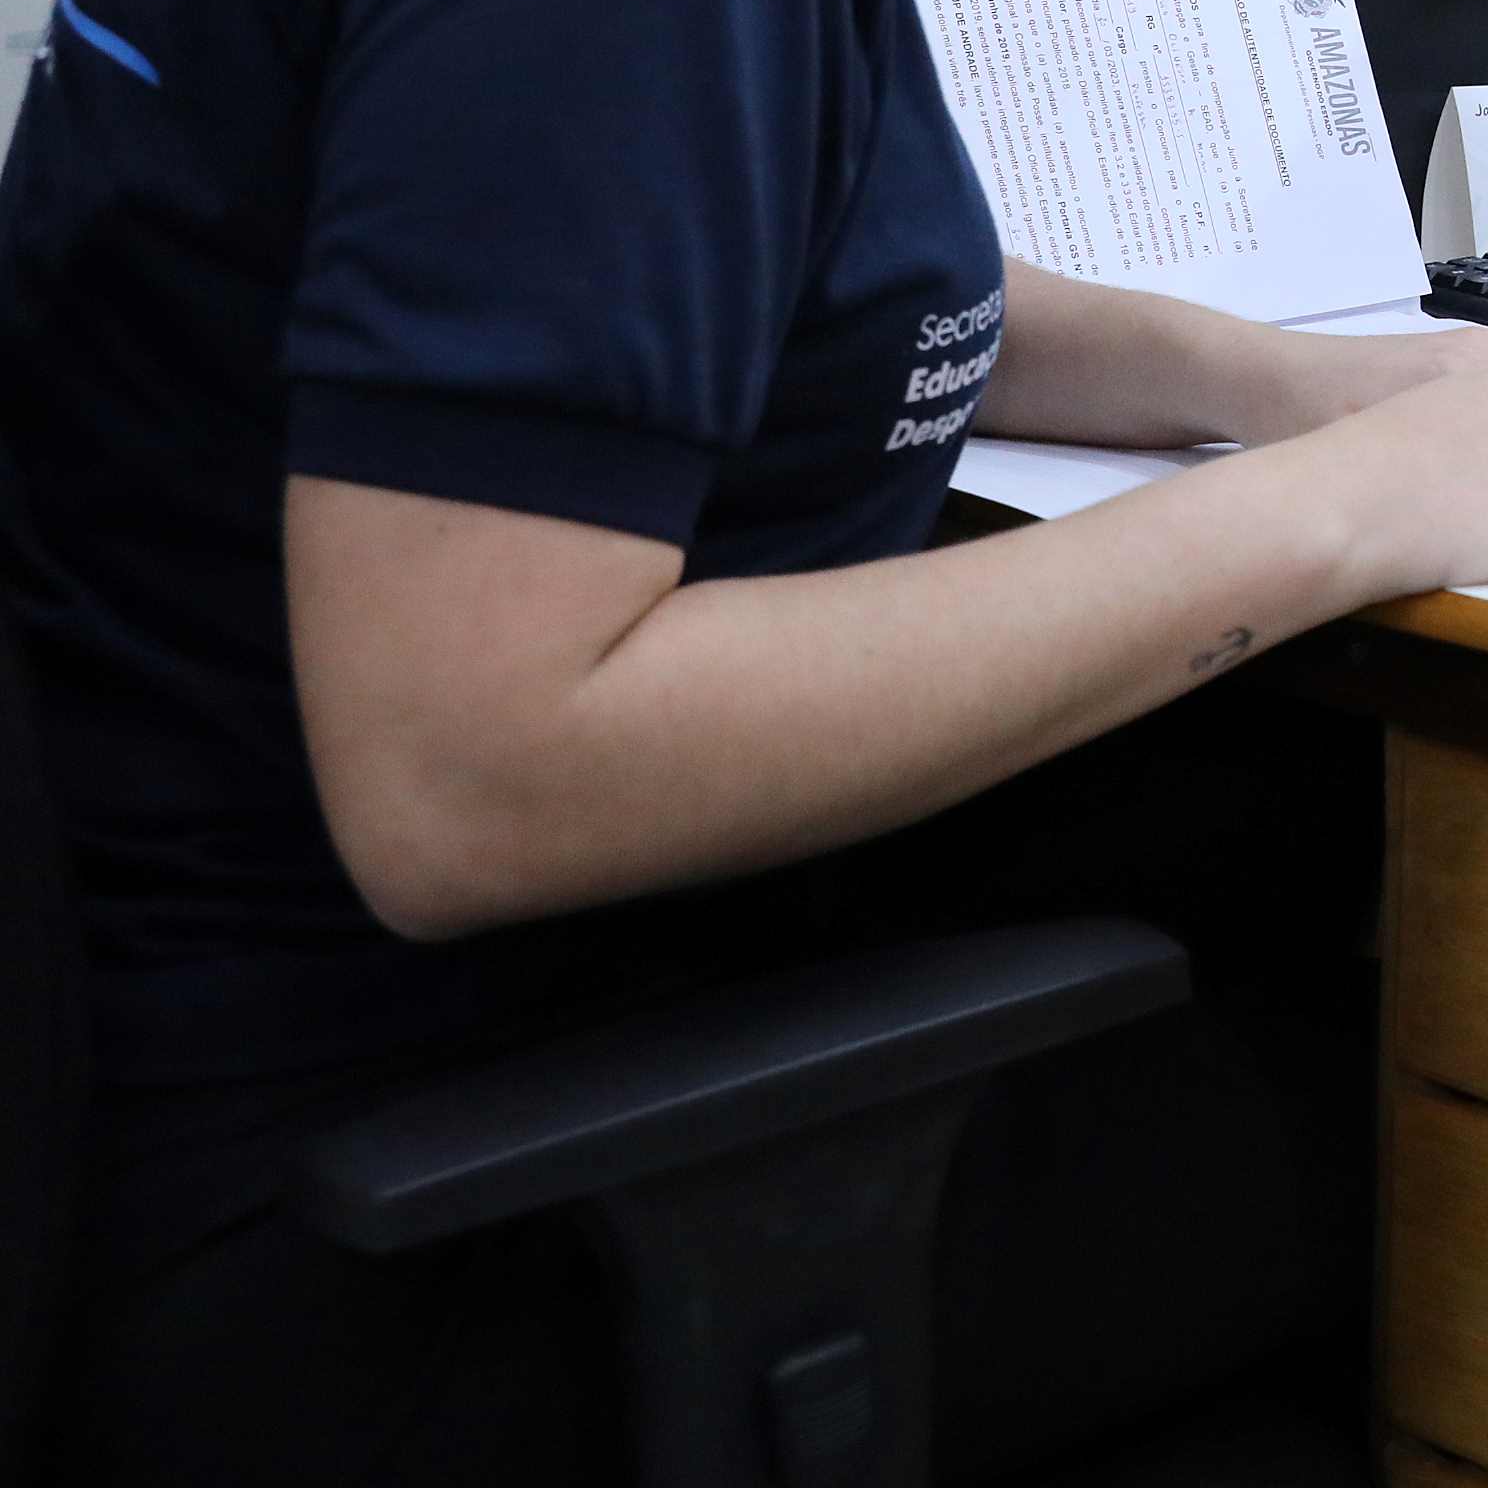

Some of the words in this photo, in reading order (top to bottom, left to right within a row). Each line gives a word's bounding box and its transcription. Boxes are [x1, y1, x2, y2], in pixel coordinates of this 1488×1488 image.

[1237, 10, 1249, 24] DE
[995, 36, 1012, 63] 2019,
[1112, 26, 1129, 54] Cargo
[1192, 17, 1204, 36] para
[1208, 81, 1232, 140] comprovação
[1242, 27, 1271, 105] AUTENTICIDADE
[1304, 49, 1321, 89] GOVERNO
[1308, 26, 1374, 157] AMAZONAS
[1315, 90, 1325, 103] DO
[1263, 107, 1275, 121] DE
[1319, 105, 1334, 136] ESTADO
[1266, 123, 1292, 187] DOCUMENTO
[1055, 201, 1075, 239] Portaria
[1191, 201, 1206, 231] C.P.F.
